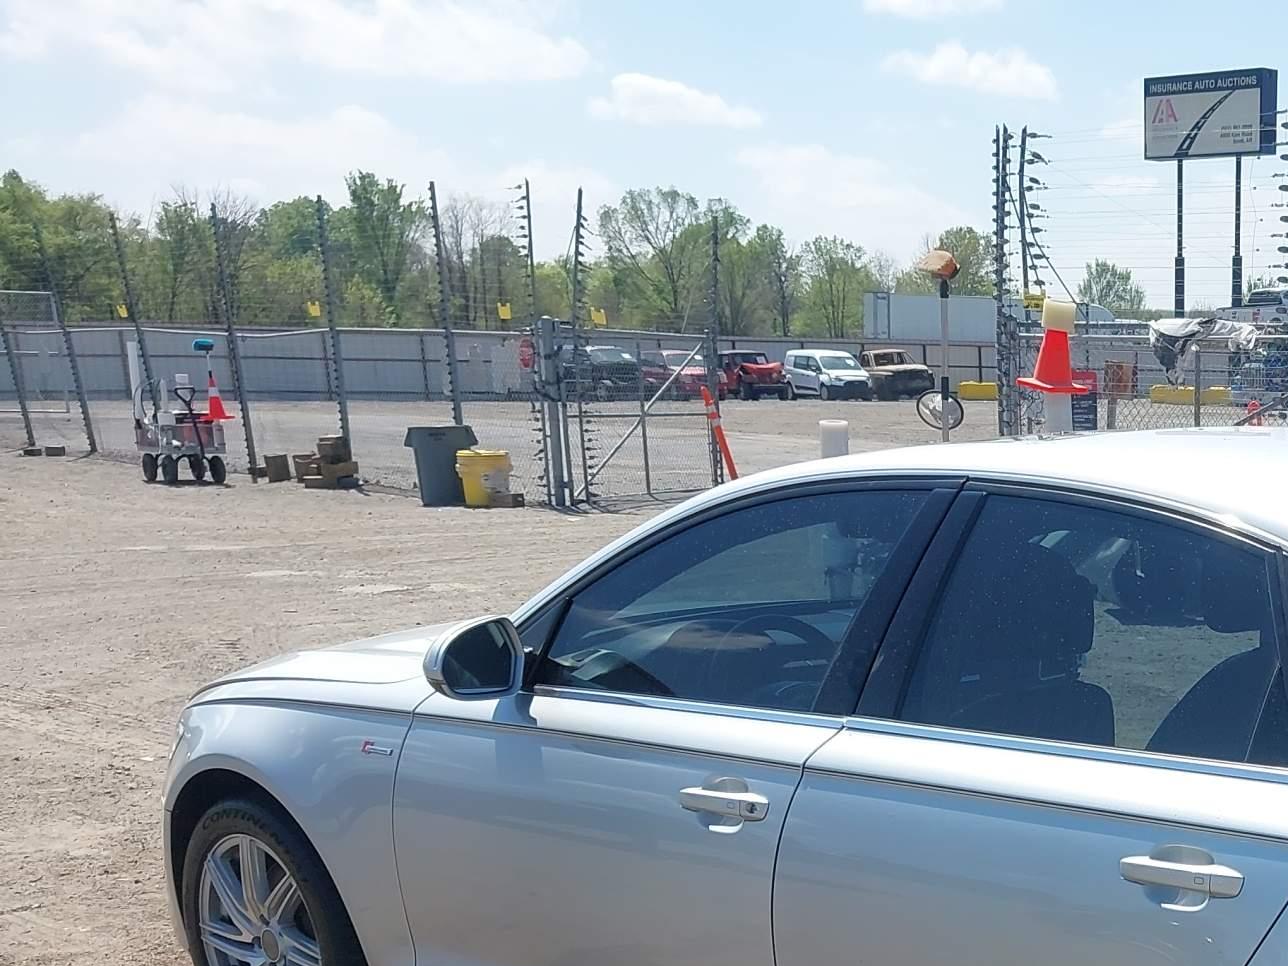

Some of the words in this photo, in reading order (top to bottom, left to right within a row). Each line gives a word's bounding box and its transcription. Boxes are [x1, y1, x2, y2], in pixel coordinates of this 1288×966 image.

[1150, 80, 1192, 94] INSURANCE
[1194, 79, 1215, 90] AUTO
[1217, 75, 1257, 88] AUCTIONS
